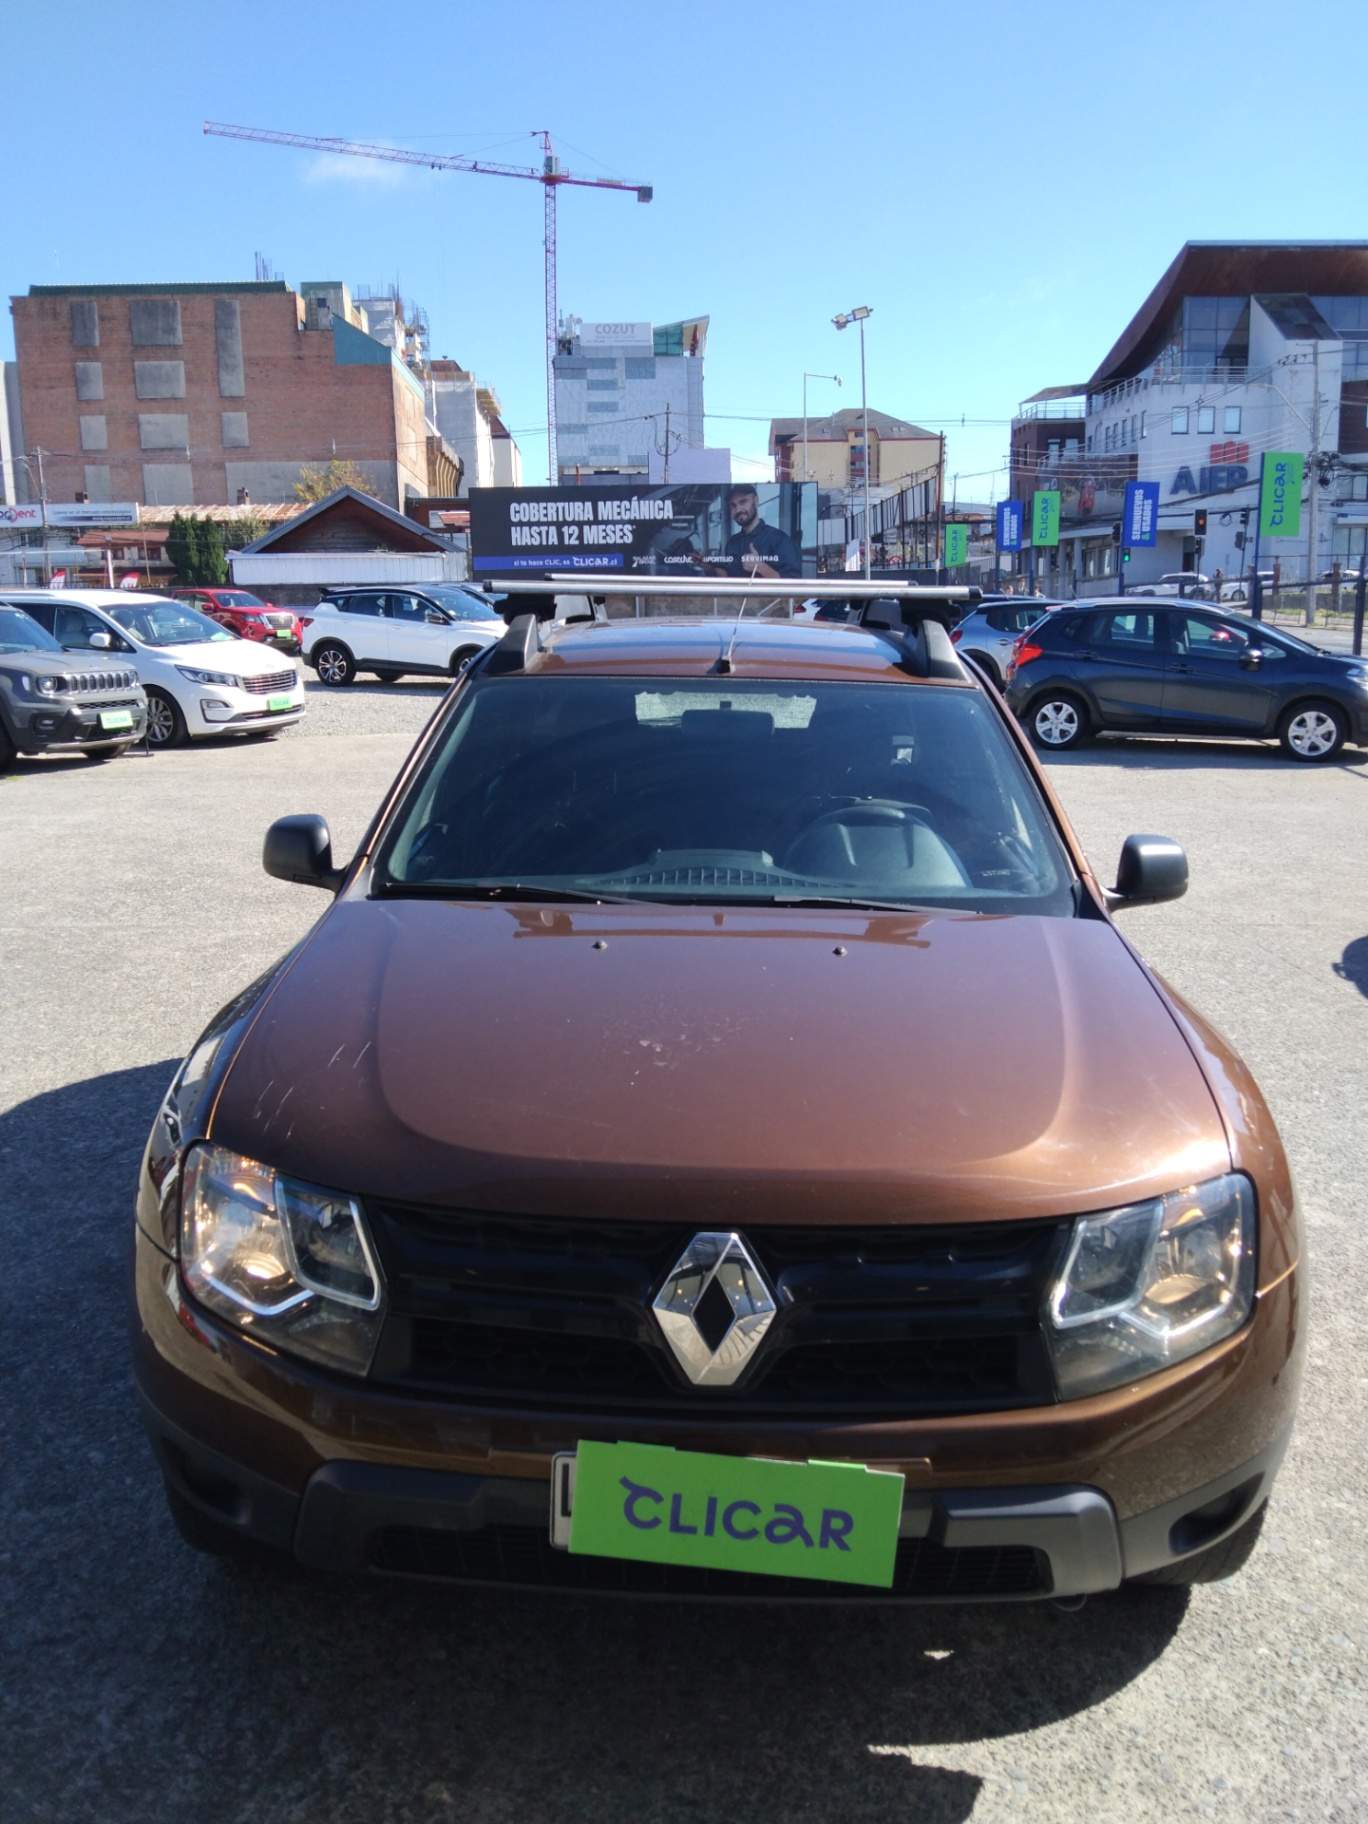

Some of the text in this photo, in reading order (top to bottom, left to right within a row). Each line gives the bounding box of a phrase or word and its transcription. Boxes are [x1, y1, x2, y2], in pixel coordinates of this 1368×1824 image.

[594, 323, 636, 335] COZUT
[509, 496, 674, 522] COBERTURA MECÁNICA
[511, 526, 559, 546] HASTA
[561, 526, 580, 545] 12
